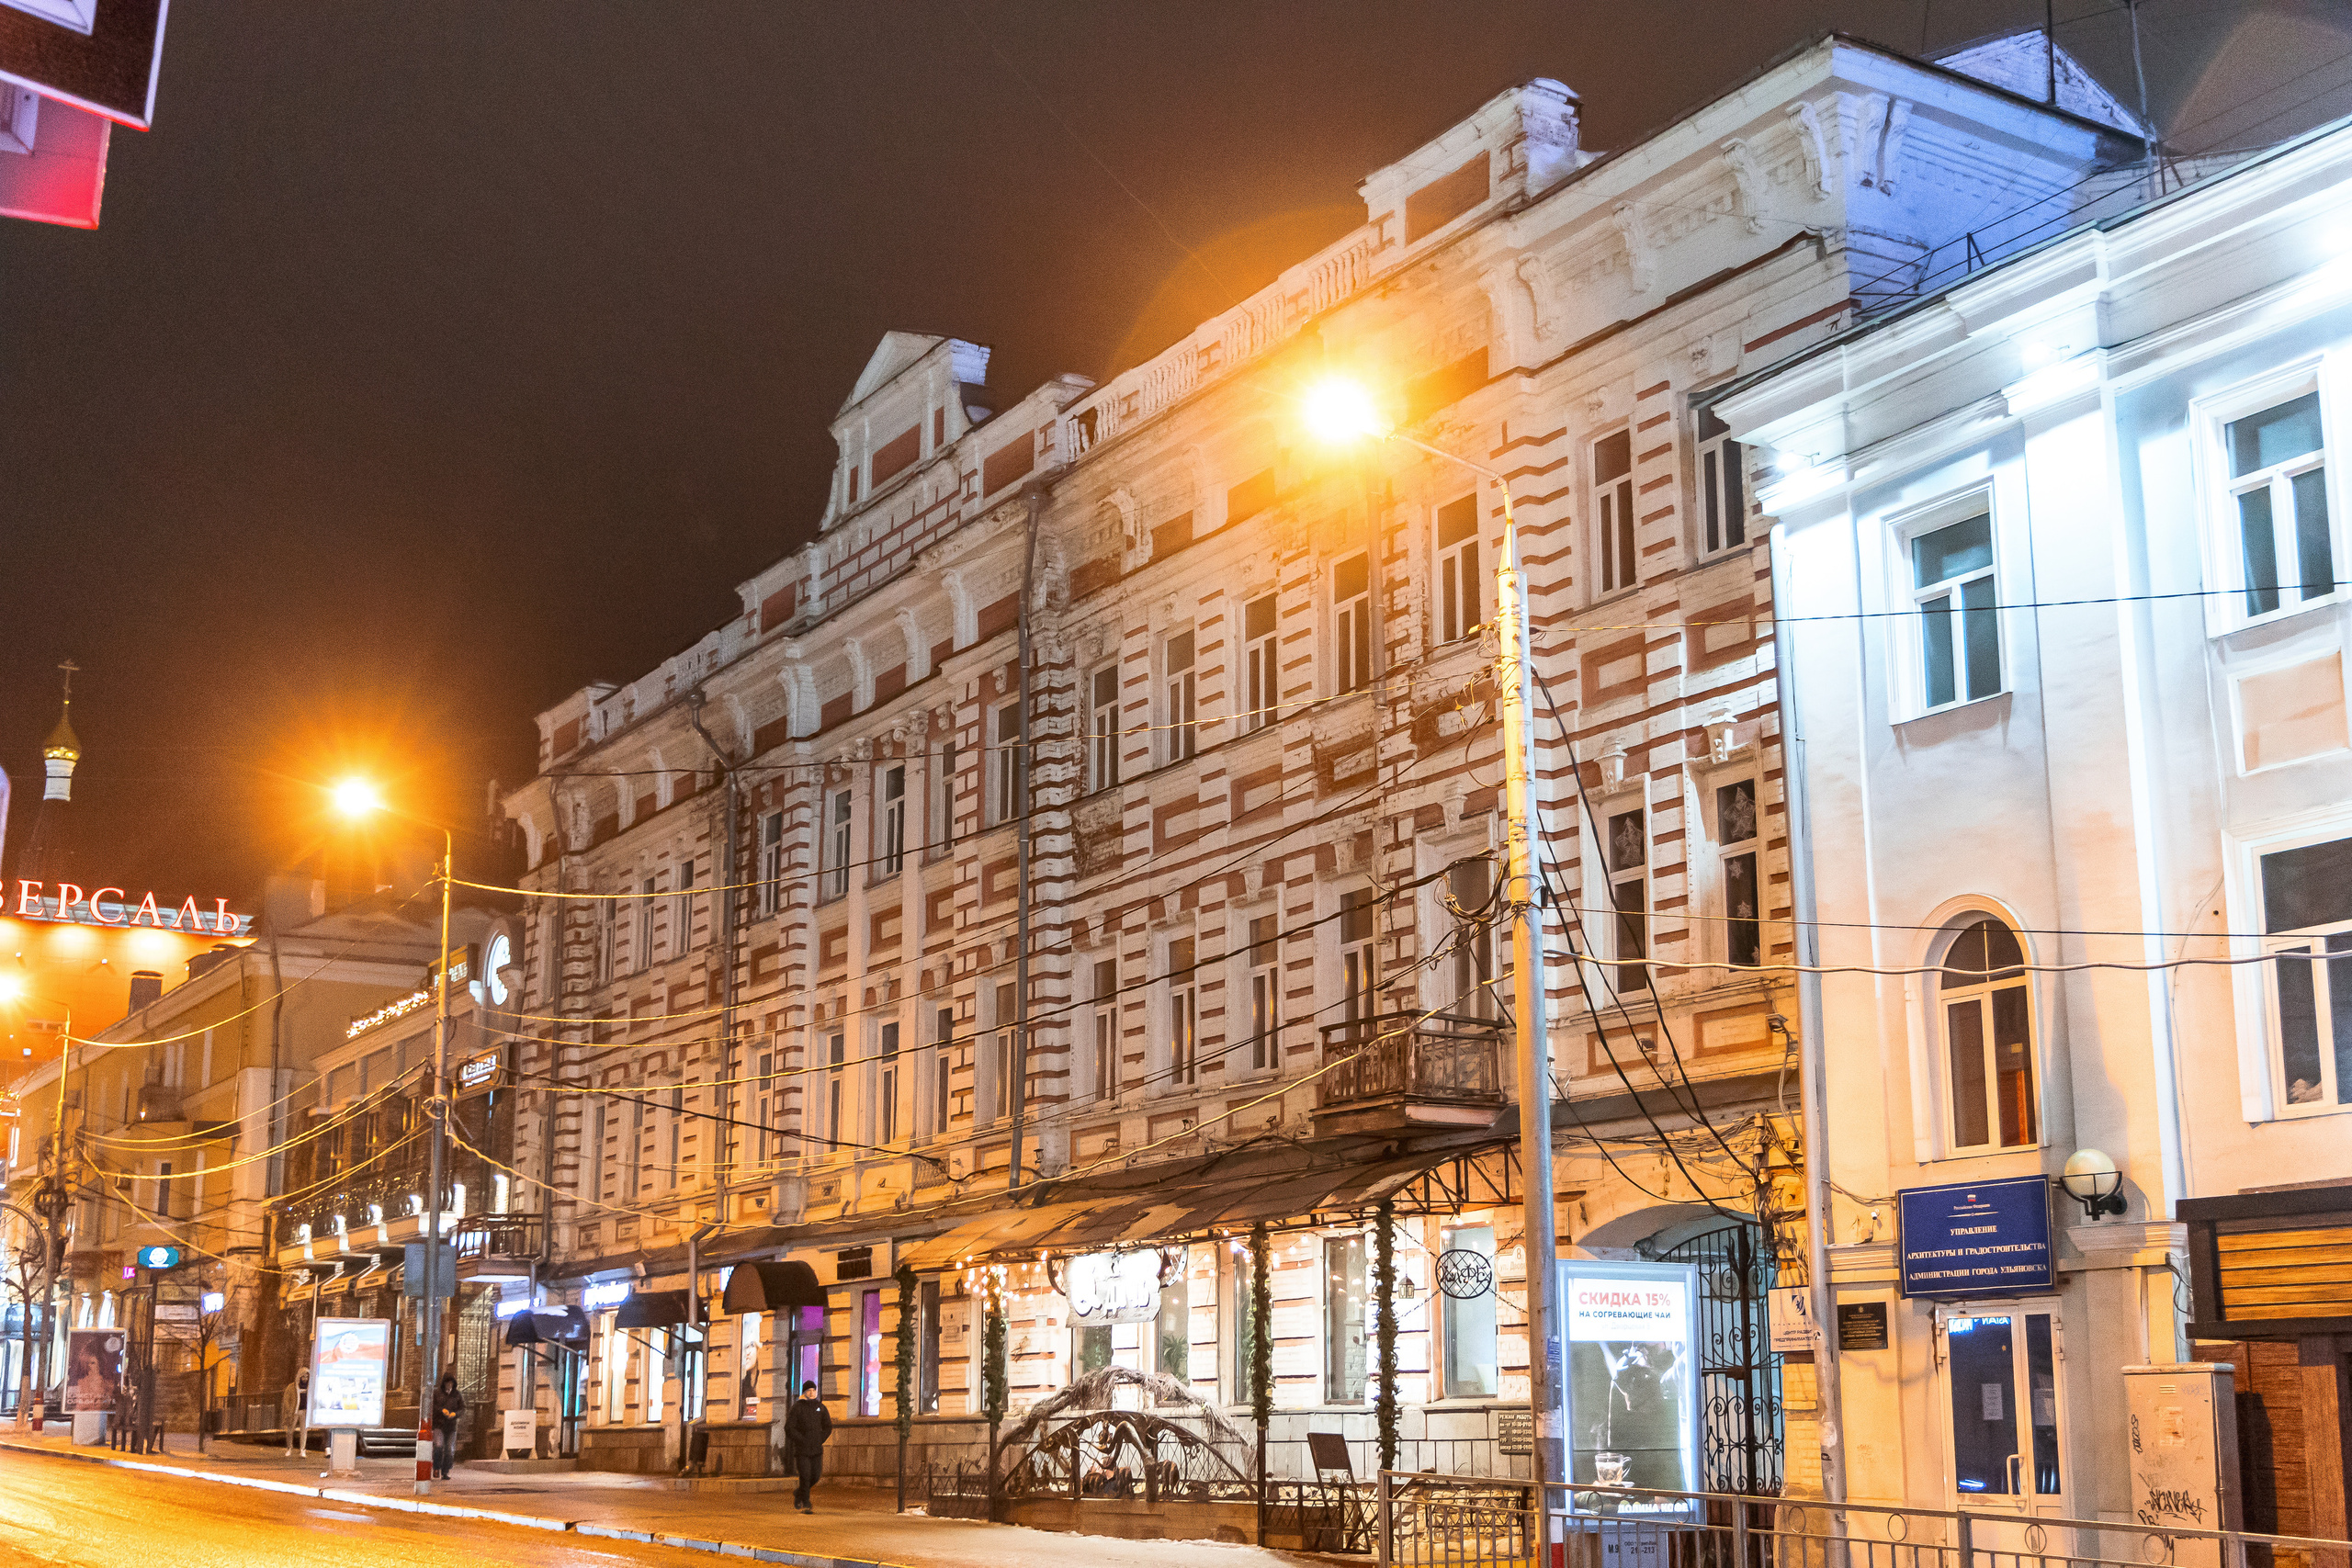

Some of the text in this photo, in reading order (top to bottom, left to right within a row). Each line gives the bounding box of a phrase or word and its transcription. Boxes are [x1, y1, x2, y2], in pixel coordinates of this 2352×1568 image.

[0, 879, 241, 933] ЕРСАЛЬ
[1950, 1225, 1997, 1236] УПРАВЛЕНИЕ
[1516, 1248, 1522, 1259] 8
[1906, 1242, 2046, 1260] АРХИТЕКТУРЫ И ГРАДОСТРОИТЕЛЬСТВА
[1909, 1264, 2047, 1280] АДМИНИСТРАЦИИ ГОРОДА УЛЬЯНОВСКА
[1578, 1292, 1670, 1307] СКИДКА 15%
[1593, 1311, 1653, 1319] СОГРЕВАЮЩИЕ
